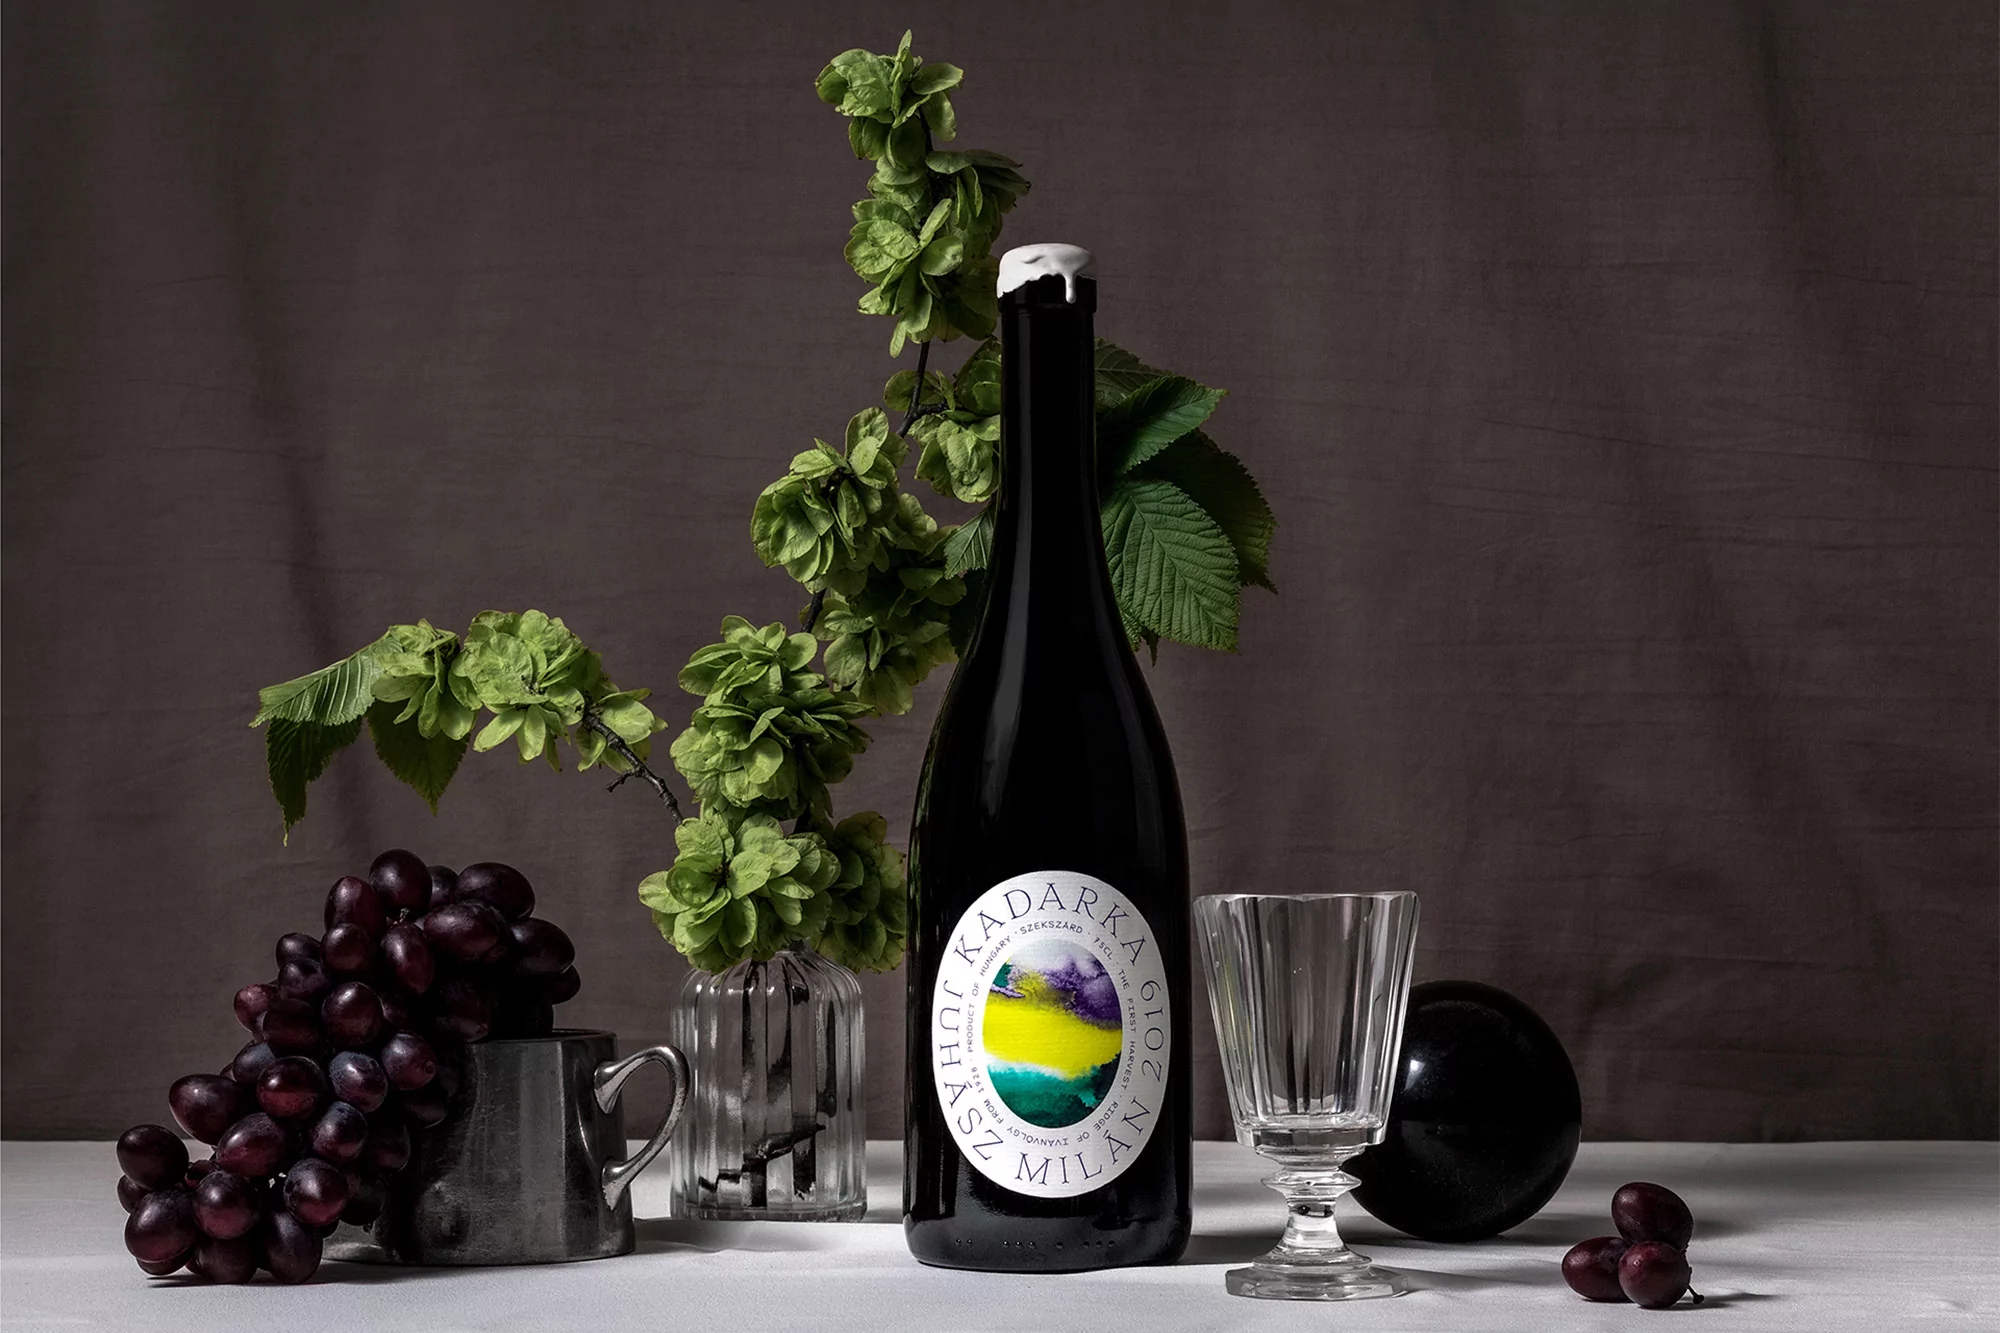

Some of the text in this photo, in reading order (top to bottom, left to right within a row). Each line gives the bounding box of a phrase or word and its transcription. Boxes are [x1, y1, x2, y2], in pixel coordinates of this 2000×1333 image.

[953, 882, 1146, 967] KADARKA
[979, 935, 1011, 976] HUNGARY
[1093, 937, 1113, 960] 75CL
[971, 981, 980, 997] OF
[1119, 968, 1130, 991] THE
[967, 1003, 976, 1053] PRODUCT
[1127, 998, 1138, 1034] FIRST
[1120, 1040, 1137, 1090] HARVEST
[939, 980, 1165, 1186] JUHÁSZ MILÁN 2019
[972, 1067, 985, 1095] 1928
[983, 1099, 1004, 1125] FROM
[1092, 1101, 1118, 1131] RIDGE
[1076, 1133, 1091, 1144] OF
